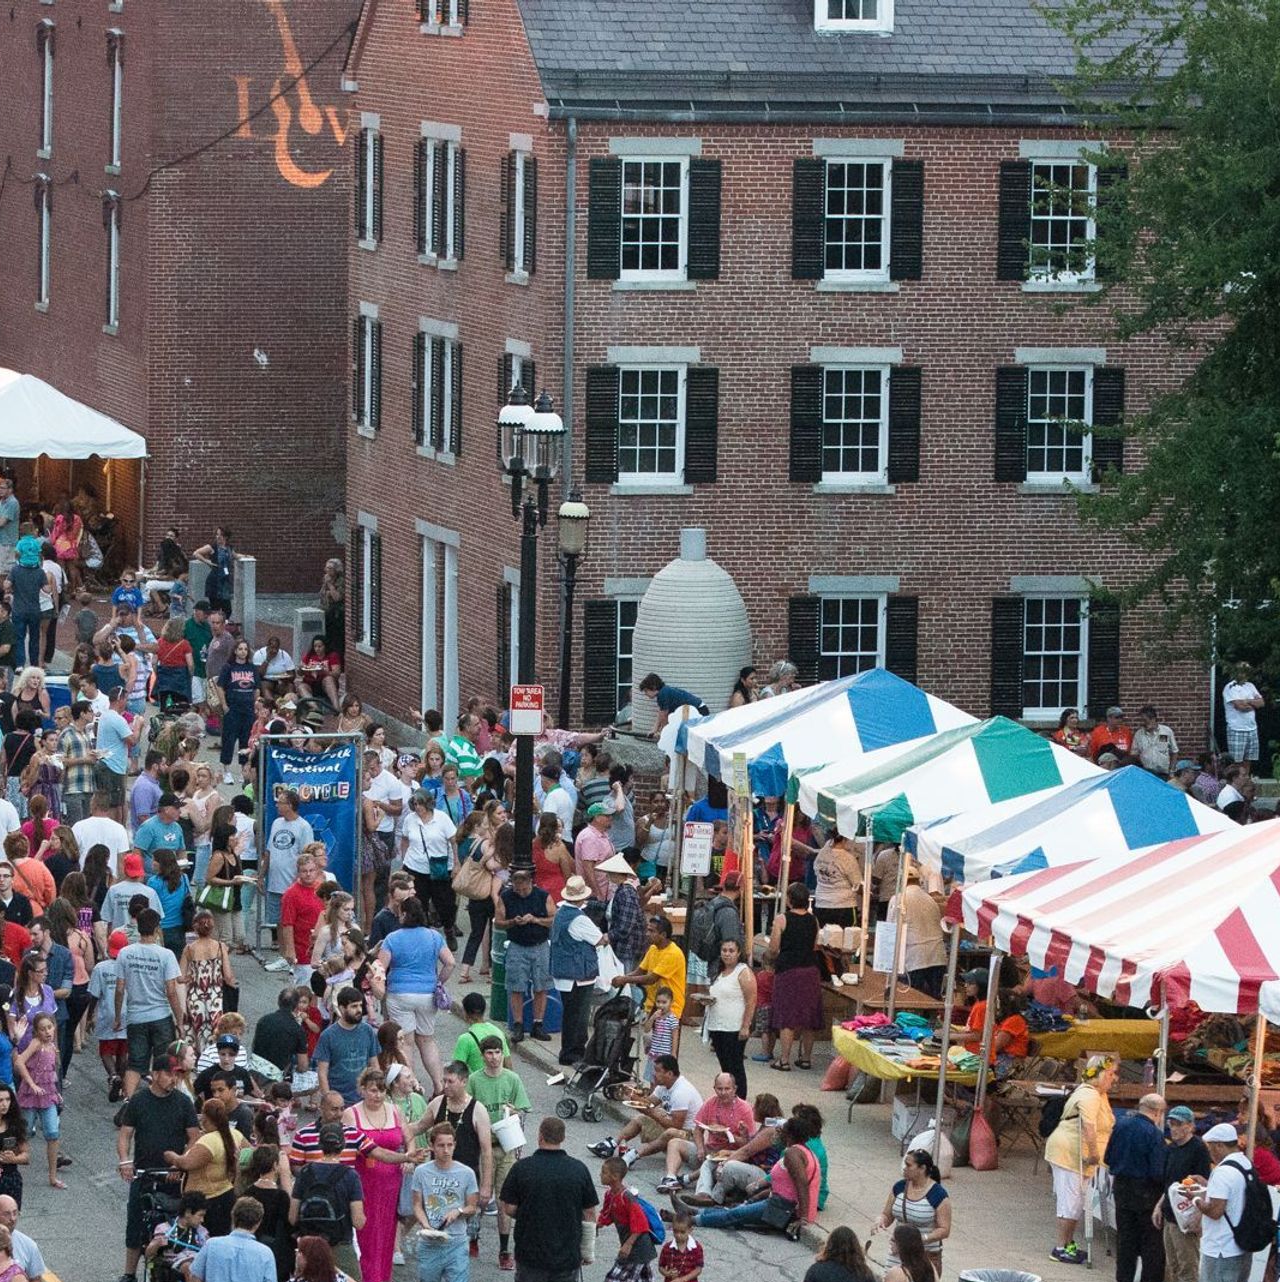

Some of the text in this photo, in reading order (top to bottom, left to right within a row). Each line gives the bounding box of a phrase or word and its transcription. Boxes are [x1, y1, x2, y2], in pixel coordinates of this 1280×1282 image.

[271, 750, 317, 763] Lowell
[282, 763, 341, 773] Festival
[431, 1177, 459, 1188] Life's
